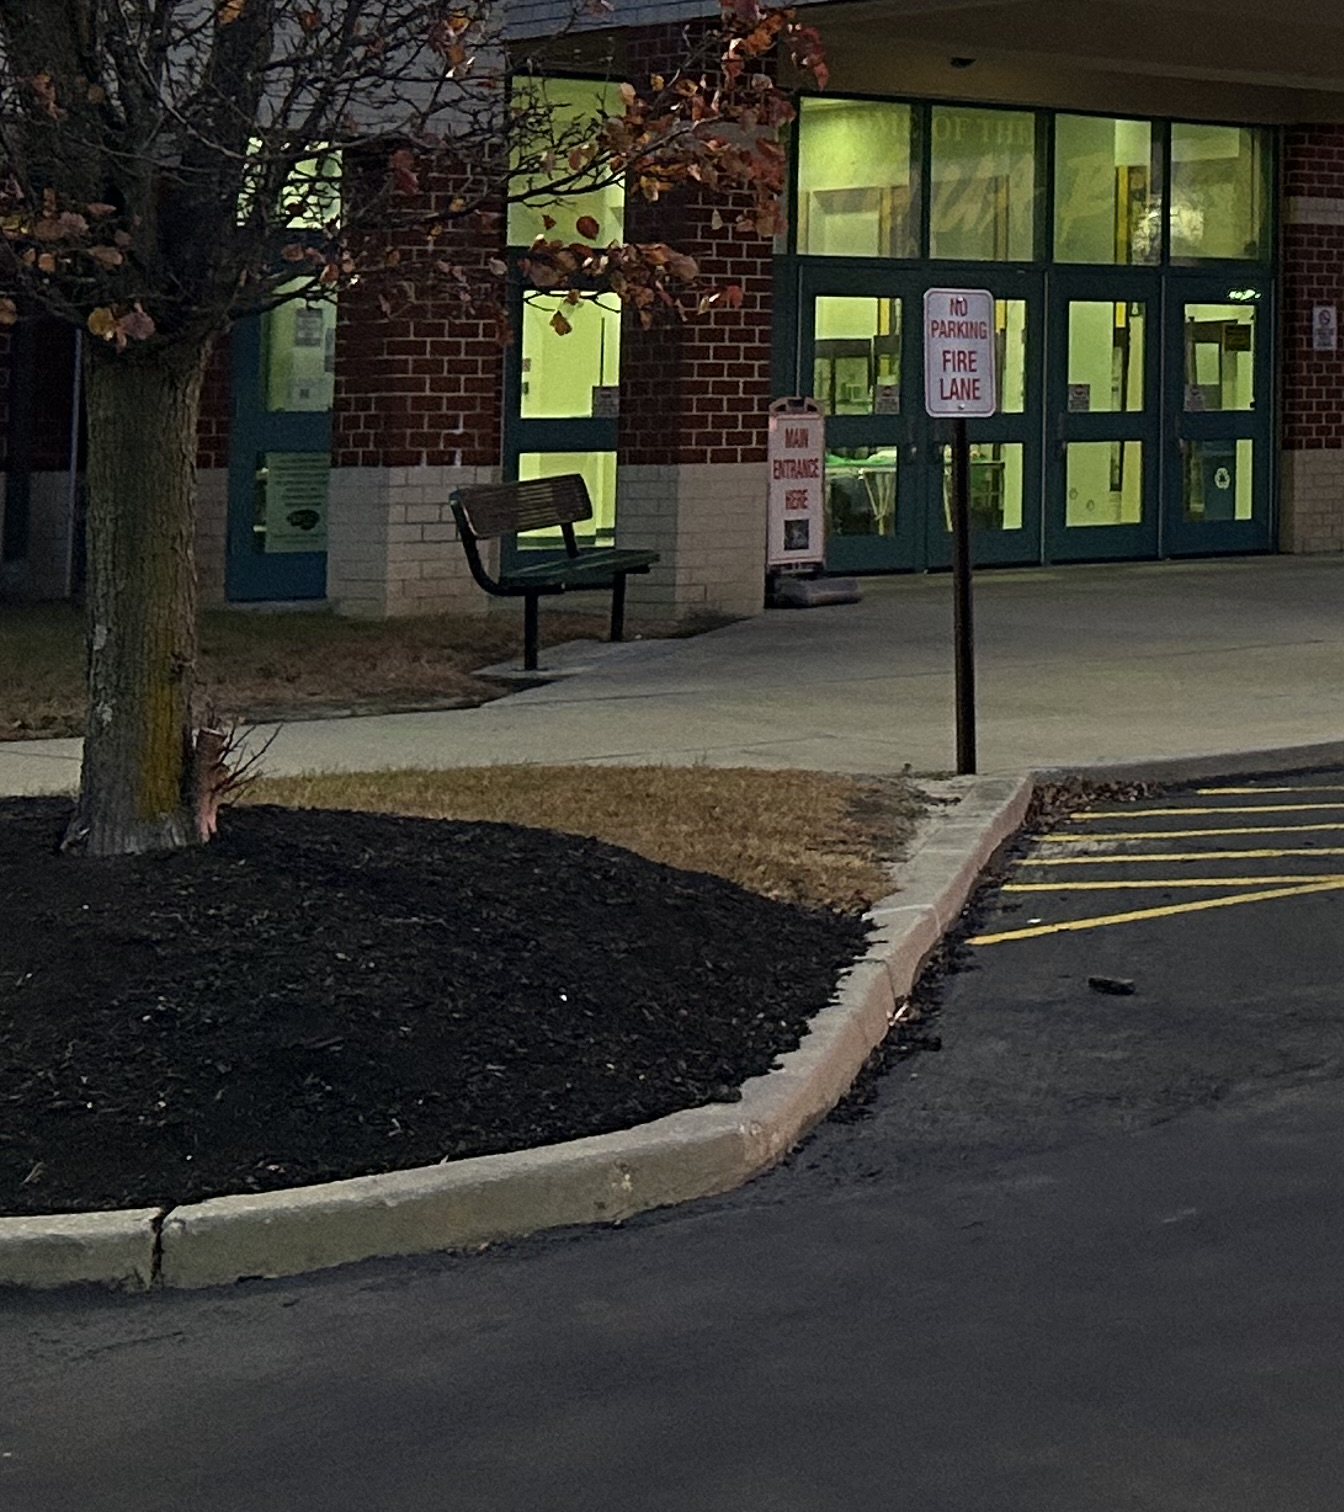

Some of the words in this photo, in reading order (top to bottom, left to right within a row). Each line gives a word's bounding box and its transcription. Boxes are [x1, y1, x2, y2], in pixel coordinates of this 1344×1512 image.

[934, 115, 969, 142] OF
[949, 297, 968, 317] NO
[931, 320, 988, 339] PARKING
[942, 350, 978, 373] FIRE
[940, 378, 982, 401] LANE
[785, 428, 808, 448] MAIN
[773, 458, 820, 480] ENTRANCE
